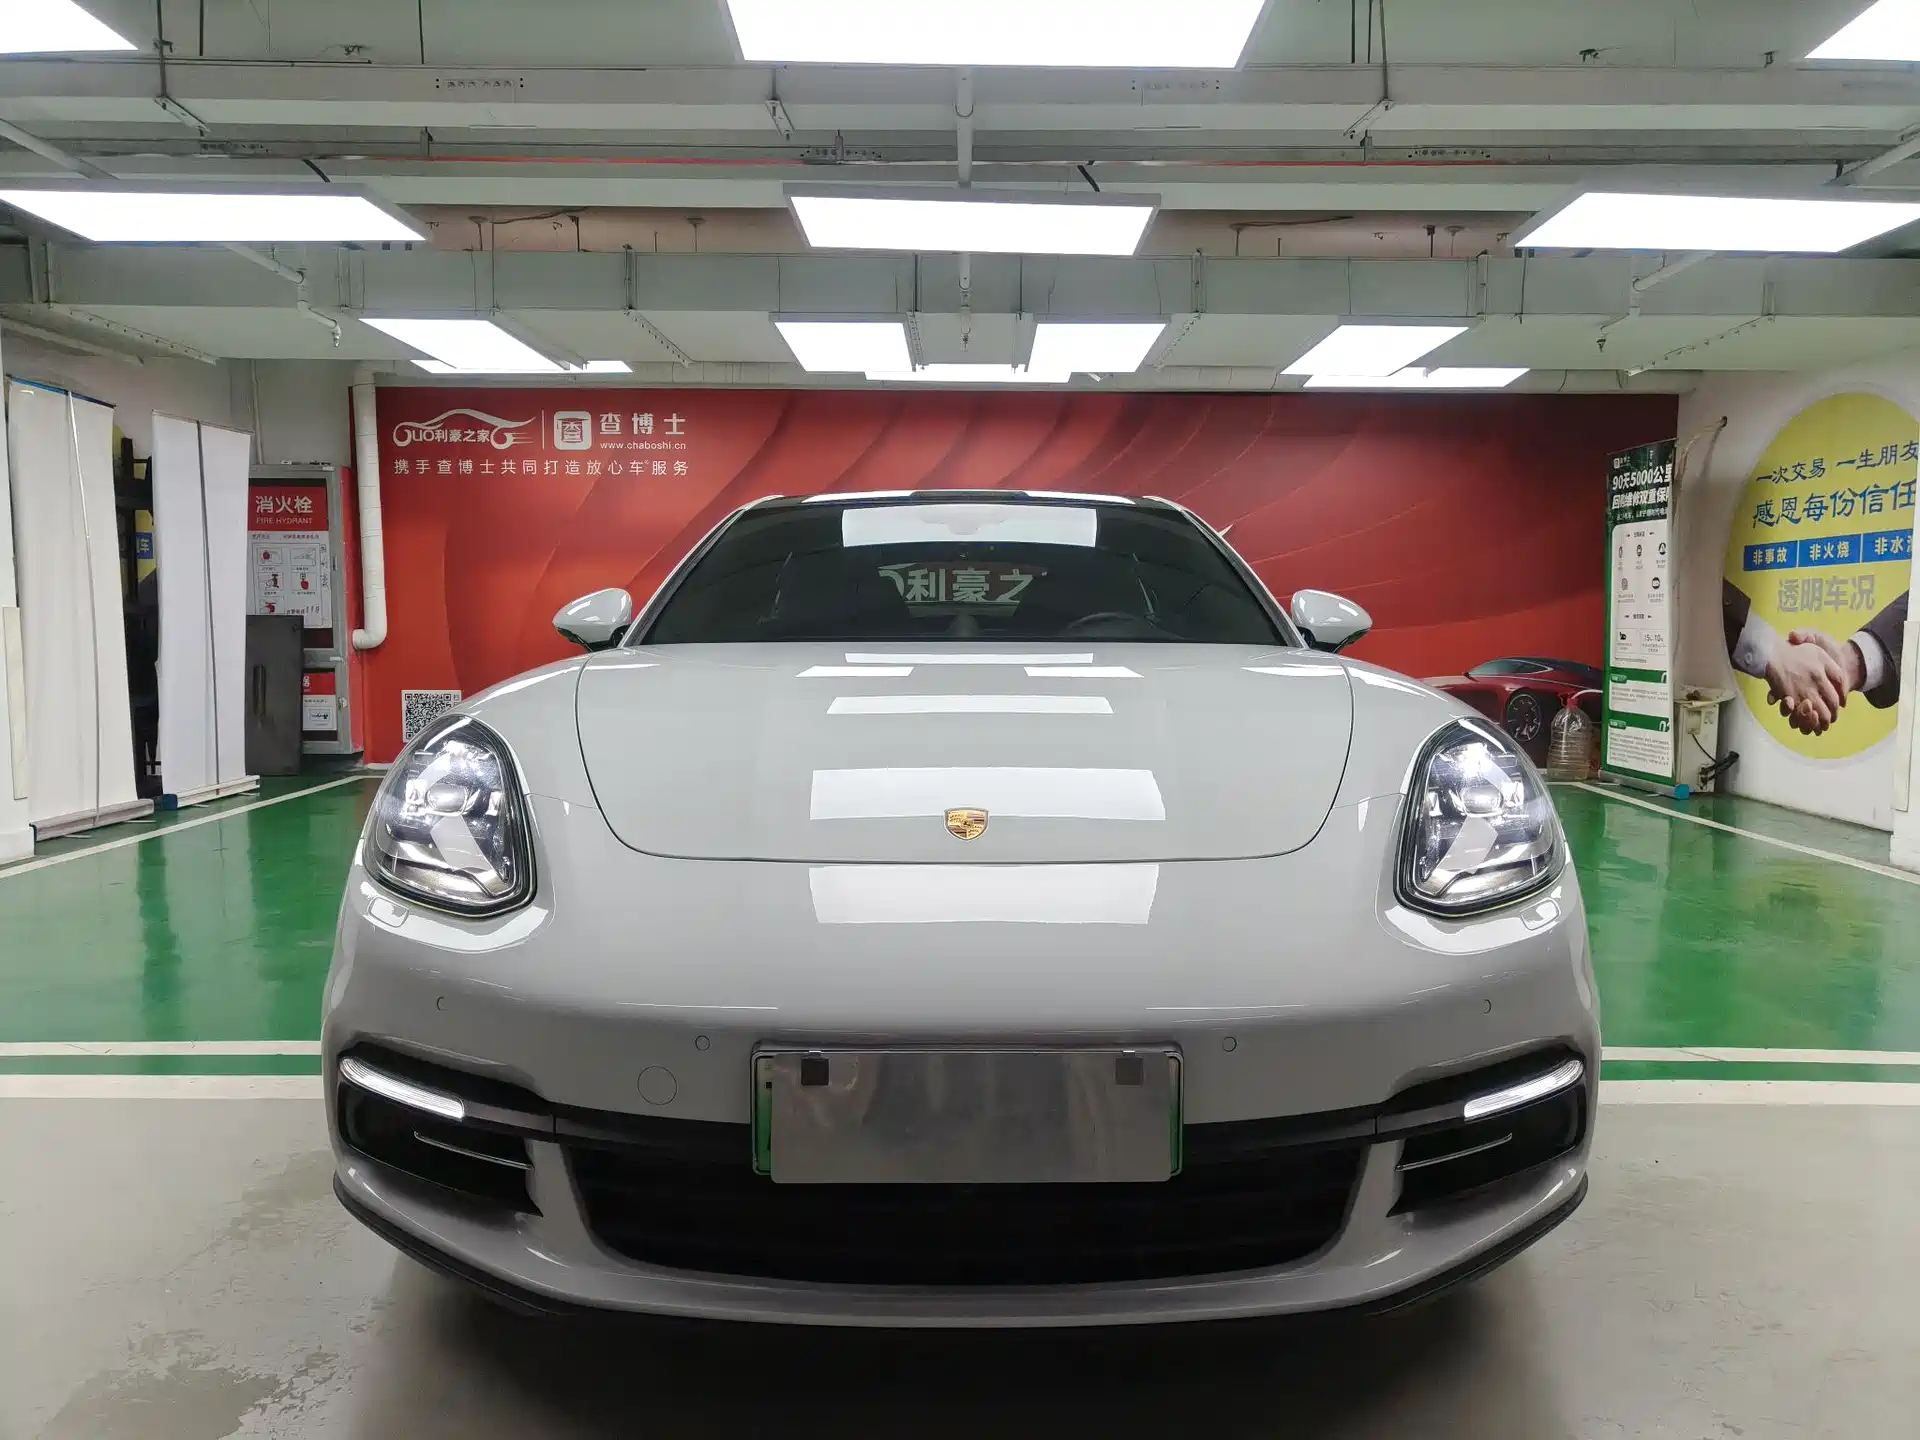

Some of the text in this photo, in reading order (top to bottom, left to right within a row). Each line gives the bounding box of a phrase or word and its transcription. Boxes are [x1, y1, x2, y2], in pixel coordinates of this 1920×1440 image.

[599, 412, 686, 435] 查博士
[600, 440, 687, 450] www.chaboshi.cn
[393, 459, 689, 476] 携手查博士共同打造放心车服务
[1756, 440, 1919, 484] 一次交易 一生朋友
[256, 495, 313, 514] 消火栓
[1753, 478, 1917, 529] 感恩每份信任
[256, 517, 313, 525] FIRE HYDRANT
[1753, 547, 1787, 566] 非事故
[1809, 541, 1850, 561] 非火烧
[1777, 574, 1876, 613] 透明车况
